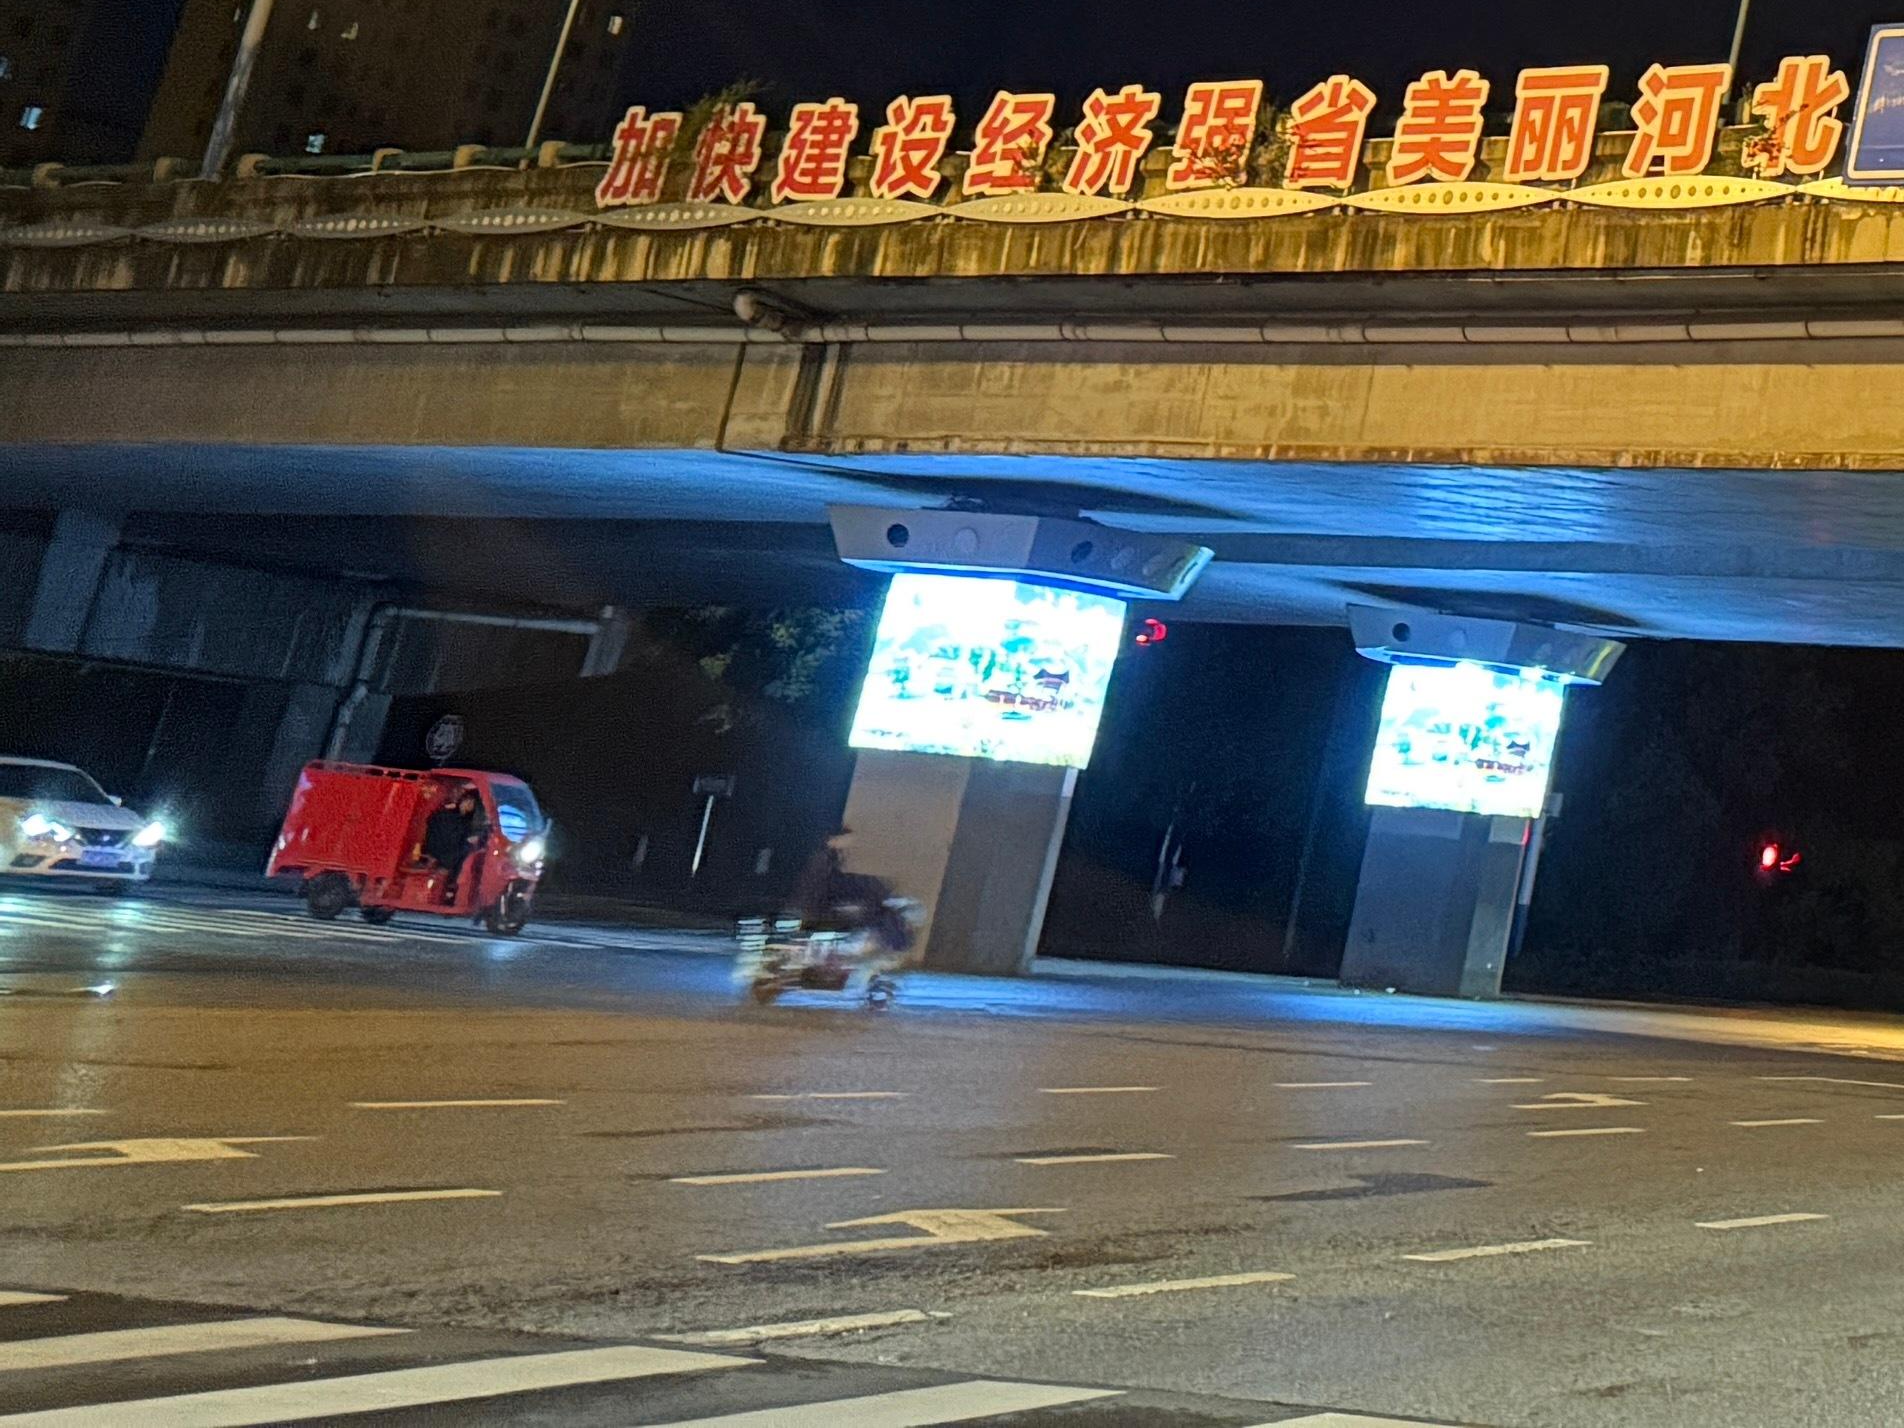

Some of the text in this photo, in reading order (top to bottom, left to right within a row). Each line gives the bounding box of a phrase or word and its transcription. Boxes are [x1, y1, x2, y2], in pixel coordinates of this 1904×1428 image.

[597, 53, 1850, 207] 加快建设经济强省美丽河北
